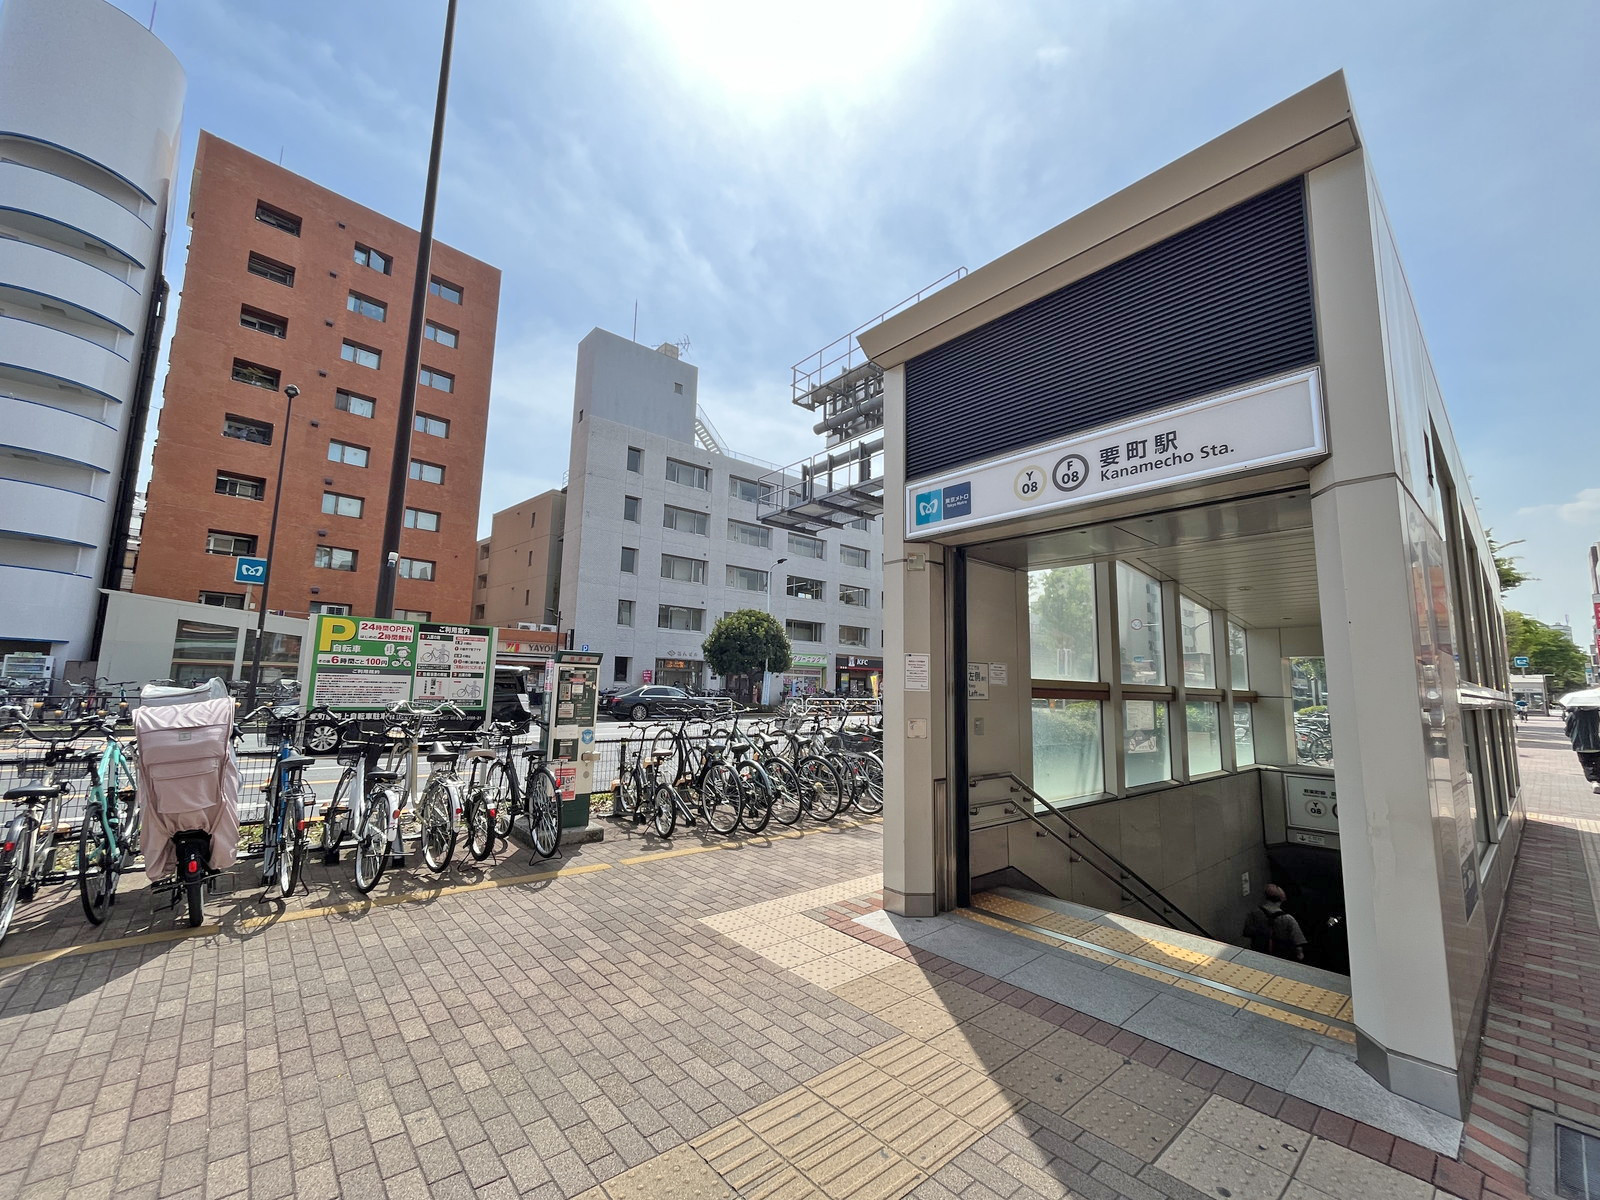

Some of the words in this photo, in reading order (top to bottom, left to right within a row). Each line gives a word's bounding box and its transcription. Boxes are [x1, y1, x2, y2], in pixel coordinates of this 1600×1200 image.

[1099, 430, 1179, 468] 要町駅
[1067, 460, 1074, 472] F
[1100, 450, 1195, 482] Kanamecho
[1199, 443, 1235, 459] Sta.
[1026, 470, 1034, 482] Y
[1061, 471, 1080, 485] 08
[1021, 481, 1039, 495] 08
[945, 493, 969, 504] 東京メトロ
[361, 622, 413, 633] 24時間OPEN
[439, 626, 470, 635] ご利用案内
[319, 617, 356, 651] P
[332, 643, 361, 653] 自転車
[856, 658, 868, 666] KFC
